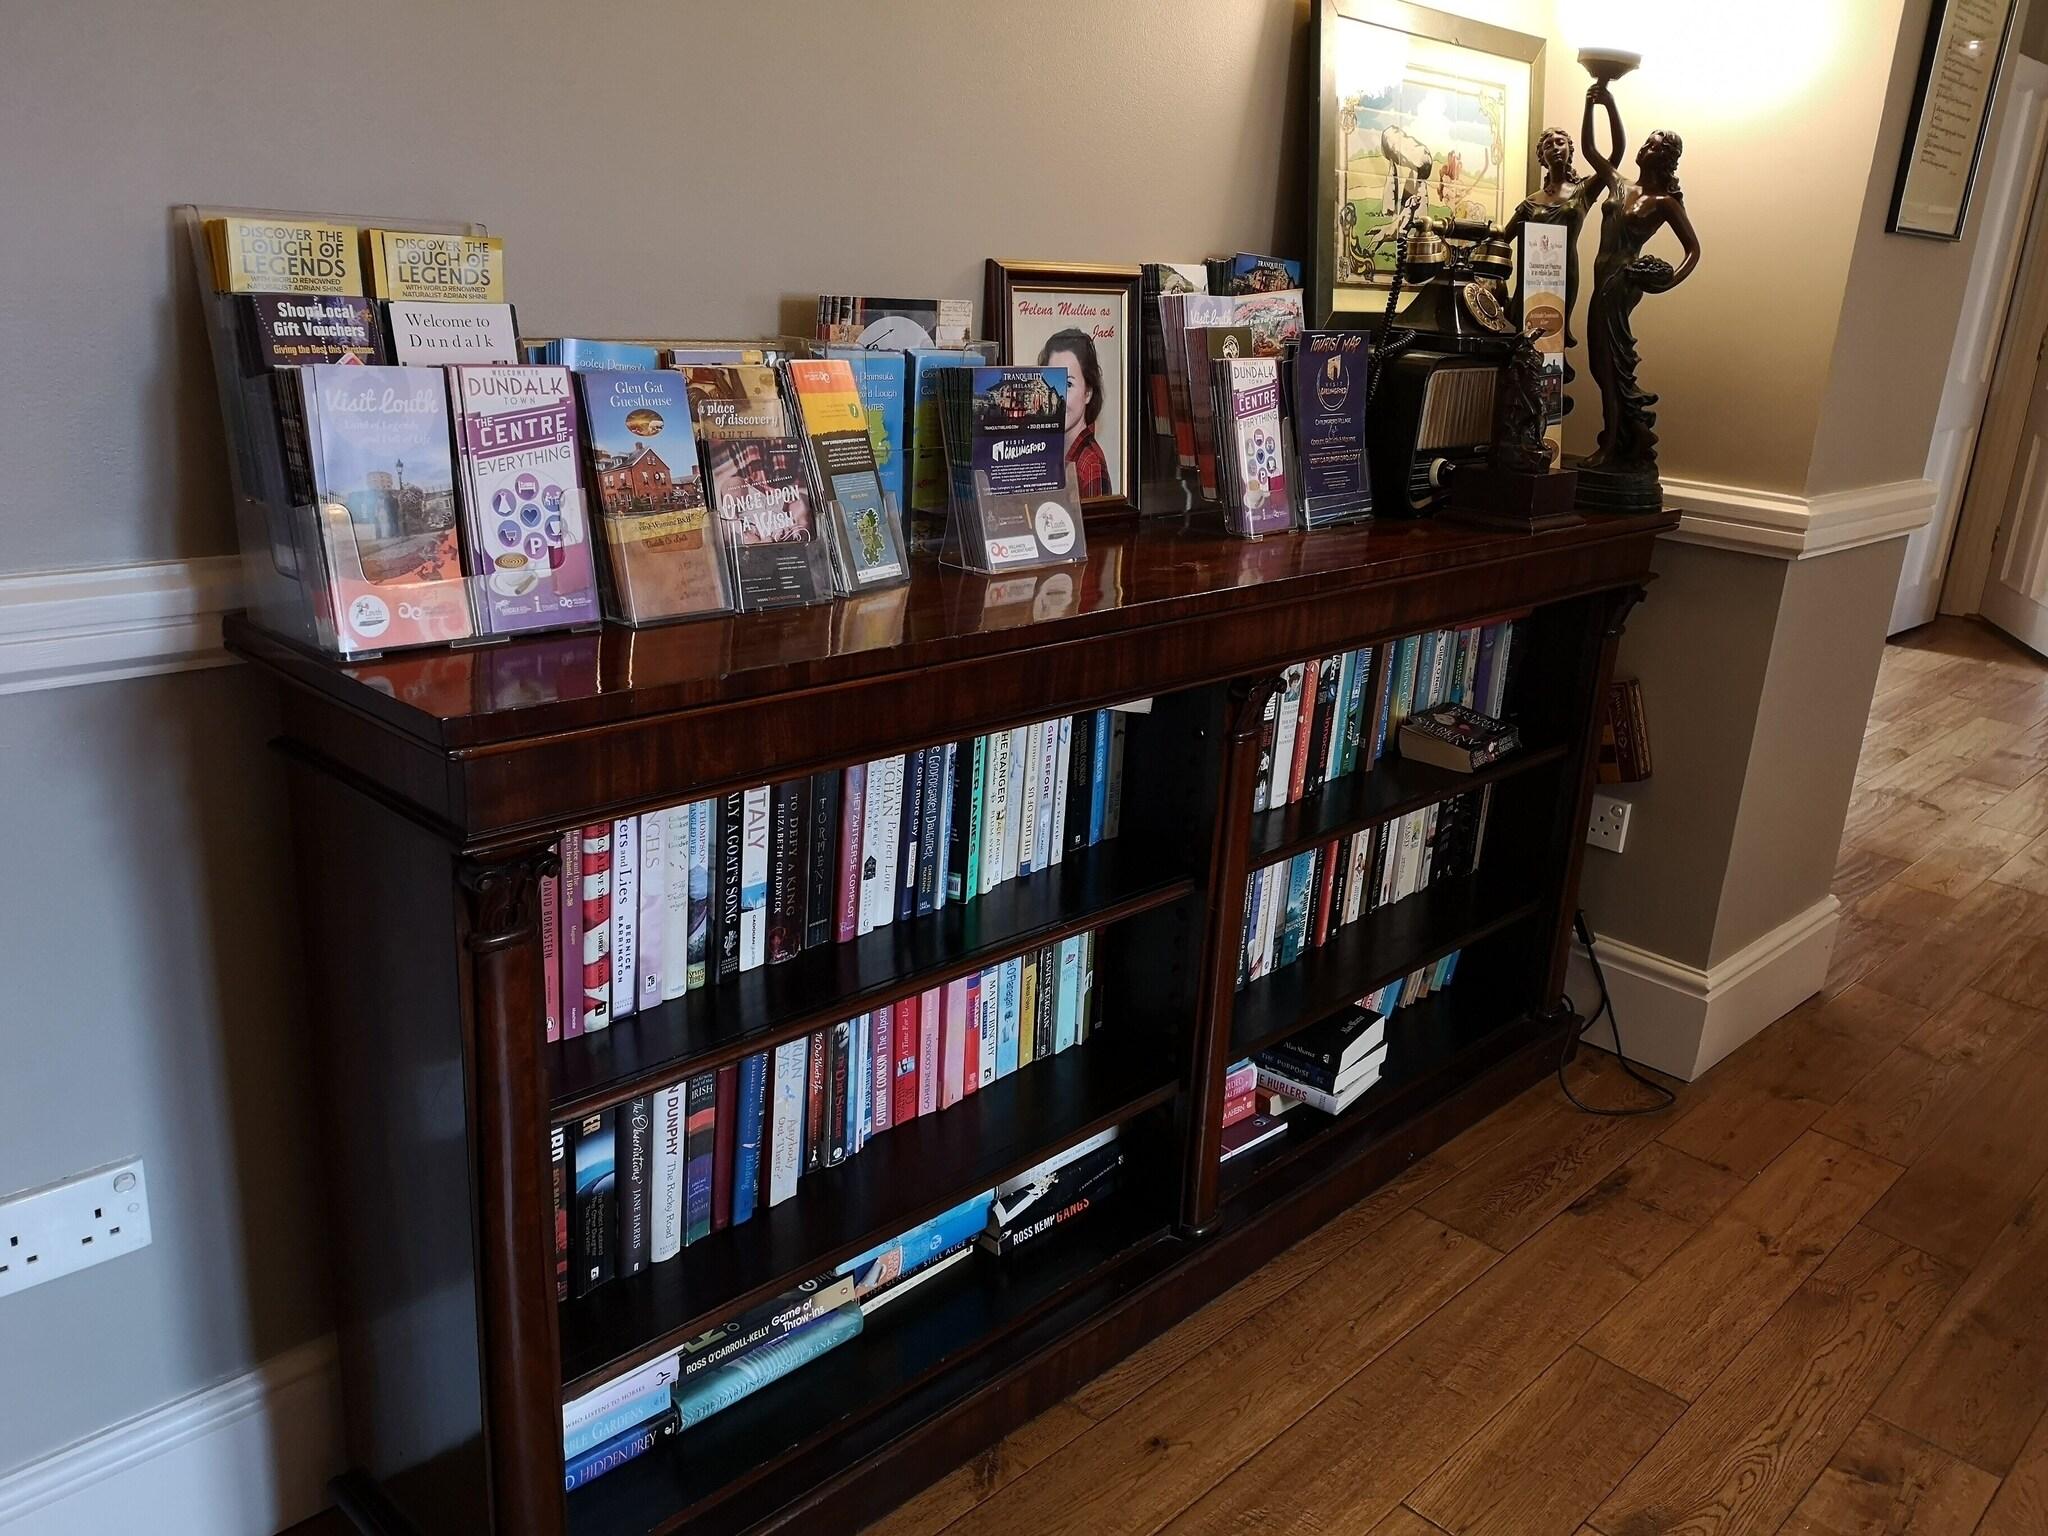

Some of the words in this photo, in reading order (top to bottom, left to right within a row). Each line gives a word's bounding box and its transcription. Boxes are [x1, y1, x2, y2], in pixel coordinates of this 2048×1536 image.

[240, 227, 312, 242] DISCOVER
[317, 230, 343, 243] THE
[395, 239, 461, 252] DISCOVER
[465, 241, 489, 253] THE
[241, 241, 312, 257] LOUGH
[321, 243, 344, 258] OF
[397, 252, 461, 267] LOUGH
[466, 254, 490, 268] OF
[242, 256, 346, 277] LEGENDS
[398, 266, 491, 286] LEGENDS
[247, 283, 293, 292] NATURALIST
[293, 284, 321, 293] ADRIAN
[322, 285, 344, 293] SHINE
[251, 276, 271, 285] WITH
[272, 277, 296, 286] WORLD
[297, 278, 341, 286] RENOWNED
[405, 283, 424, 292] WITH
[425, 284, 447, 292] WORLD
[448, 285, 486, 293] RENOWNED
[402, 290, 443, 299] NATURALIST
[444, 291, 467, 299] ADRIAN
[468, 292, 488, 300] SHINE
[278, 302, 313, 323] Shop
[319, 303, 356, 320] Local
[405, 313, 471, 328] Welcome
[475, 316, 490, 328] to
[1018, 301, 1053, 316] Helena
[1058, 302, 1097, 317] Mullins
[1100, 308, 1111, 317] as
[273, 321, 299, 337] Gift
[302, 321, 365, 338] Vouchers
[409, 332, 495, 349] Dundalk
[1091, 325, 1115, 343] Jack
[273, 344, 295, 356] Giving
[298, 344, 309, 354] the
[311, 345, 326, 354] Best
[328, 346, 341, 355] this
[1310, 334, 1345, 352] TOURIST
[1342, 335, 1363, 352] MAP
[1003, 373, 1044, 383] TRANQUILITY
[1234, 366, 1275, 379] DUNDALK
[468, 377, 565, 397] DUNDALK
[615, 382, 641, 394] Glen
[644, 381, 664, 394] Gat
[326, 388, 376, 412] Visit
[379, 388, 439, 414] Louth
[504, 396, 537, 406] TOWN
[610, 395, 672, 407] Guesthouse
[707, 403, 735, 417] place
[1239, 389, 1276, 412] CENTRE
[475, 417, 493, 428] THE
[480, 412, 568, 448] CENTRE
[715, 413, 727, 427] of
[728, 412, 778, 428] discovery
[1238, 411, 1278, 430] EVERYTHING
[556, 431, 569, 442] OF
[477, 446, 571, 476] EVERYTHING
[1004, 442, 1047, 460] CARLINGFORD
[723, 492, 762, 520] ONCE
[766, 485, 800, 506] UPON
[743, 516, 751, 532] A
[1046, 725, 1054, 751] GIRL
[1318, 717, 1331, 769] Innocent
[997, 753, 1008, 804] RANGER
[1043, 755, 1053, 799] BEFORE
[790, 794, 798, 811] TO
[853, 792, 861, 811] HET
[913, 789, 922, 815] more
[1027, 800, 1034, 811] OF
[1028, 787, 1035, 799] US
[727, 823, 740, 836] A
[748, 787, 766, 849] ITALY
[776, 804, 784, 858] ELIZABETH
[911, 818, 919, 836] day
[970, 797, 979, 857] JAMES
[1025, 811, 1033, 838] LIKES
[699, 811, 707, 864] THOMPSON
[788, 818, 798, 856] DEFY
[815, 798, 828, 895] TORMENT
[848, 815, 860, 871] ZWITSERSE
[885, 821, 897, 859] Perfect
[1024, 840, 1032, 857] THE
[620, 850, 629, 867] and
[725, 836, 739, 884] GOAT'S
[619, 869, 632, 905] Lies
[774, 861, 783, 914] CHADWICK
[883, 865, 893, 893] Love
[543, 881, 553, 907] DAVID
[724, 886, 738, 925] SONG
[785, 877, 797, 917] KING
[847, 873, 857, 919] COMPLOT
[543, 911, 553, 959] BORNSTEIN
[624, 924, 632, 971] BERNICE
[1044, 951, 1053, 984] KEVIN
[1004, 968, 1016, 1009] O'Flanagan
[1042, 987, 1051, 1028] KEEGAN
[877, 1036, 887, 1053] The
[901, 1032, 909, 1049] Time
[987, 1019, 995, 1056] BINCHY
[923, 1033, 932, 1070] COOKSON
[876, 1054, 888, 1087] COOKSON
[691, 1084, 713, 1100] IRISH
[923, 1071, 931, 1110] CATHERINE
[1267, 1078, 1307, 1101] HURLERS
[632, 1098, 644, 1115] The
[876, 1088, 887, 1126] CATHERINE
[665, 1100, 679, 1156] DUNPHY
[631, 1114, 648, 1185] Observations
[786, 1119, 799, 1169] Anybody
[667, 1161, 677, 1181] The
[741, 1154, 754, 1190] Holding
[632, 1189, 641, 1212] JANE
[665, 1183, 675, 1213] Rocky
[631, 1213, 641, 1249] HARRIS
[665, 1214, 675, 1239] Road
[1013, 1227, 1033, 1245] ROSS
[1034, 1214, 1056, 1234] KEMP
[1056, 1198, 1090, 1222] GANGS
[881, 1266, 918, 1289] GENOVA
[923, 1253, 943, 1267] STILL
[945, 1240, 967, 1256] ALICE
[771, 1309, 801, 1326] Game
[802, 1299, 813, 1311] of
[783, 1305, 825, 1332] Throw-ins
[686, 1357, 707, 1374] ROSS
[708, 1325, 770, 1364] O'CARROLL-KELLY
[697, 1401, 716, 1418] THE
[807, 1333, 838, 1356] BANKS
[584, 1404, 610, 1423] LISTENS
[592, 1407, 643, 1440] GARDENS
[580, 1449, 628, 1483] HIDDEN
[631, 1431, 657, 1455] PREY
